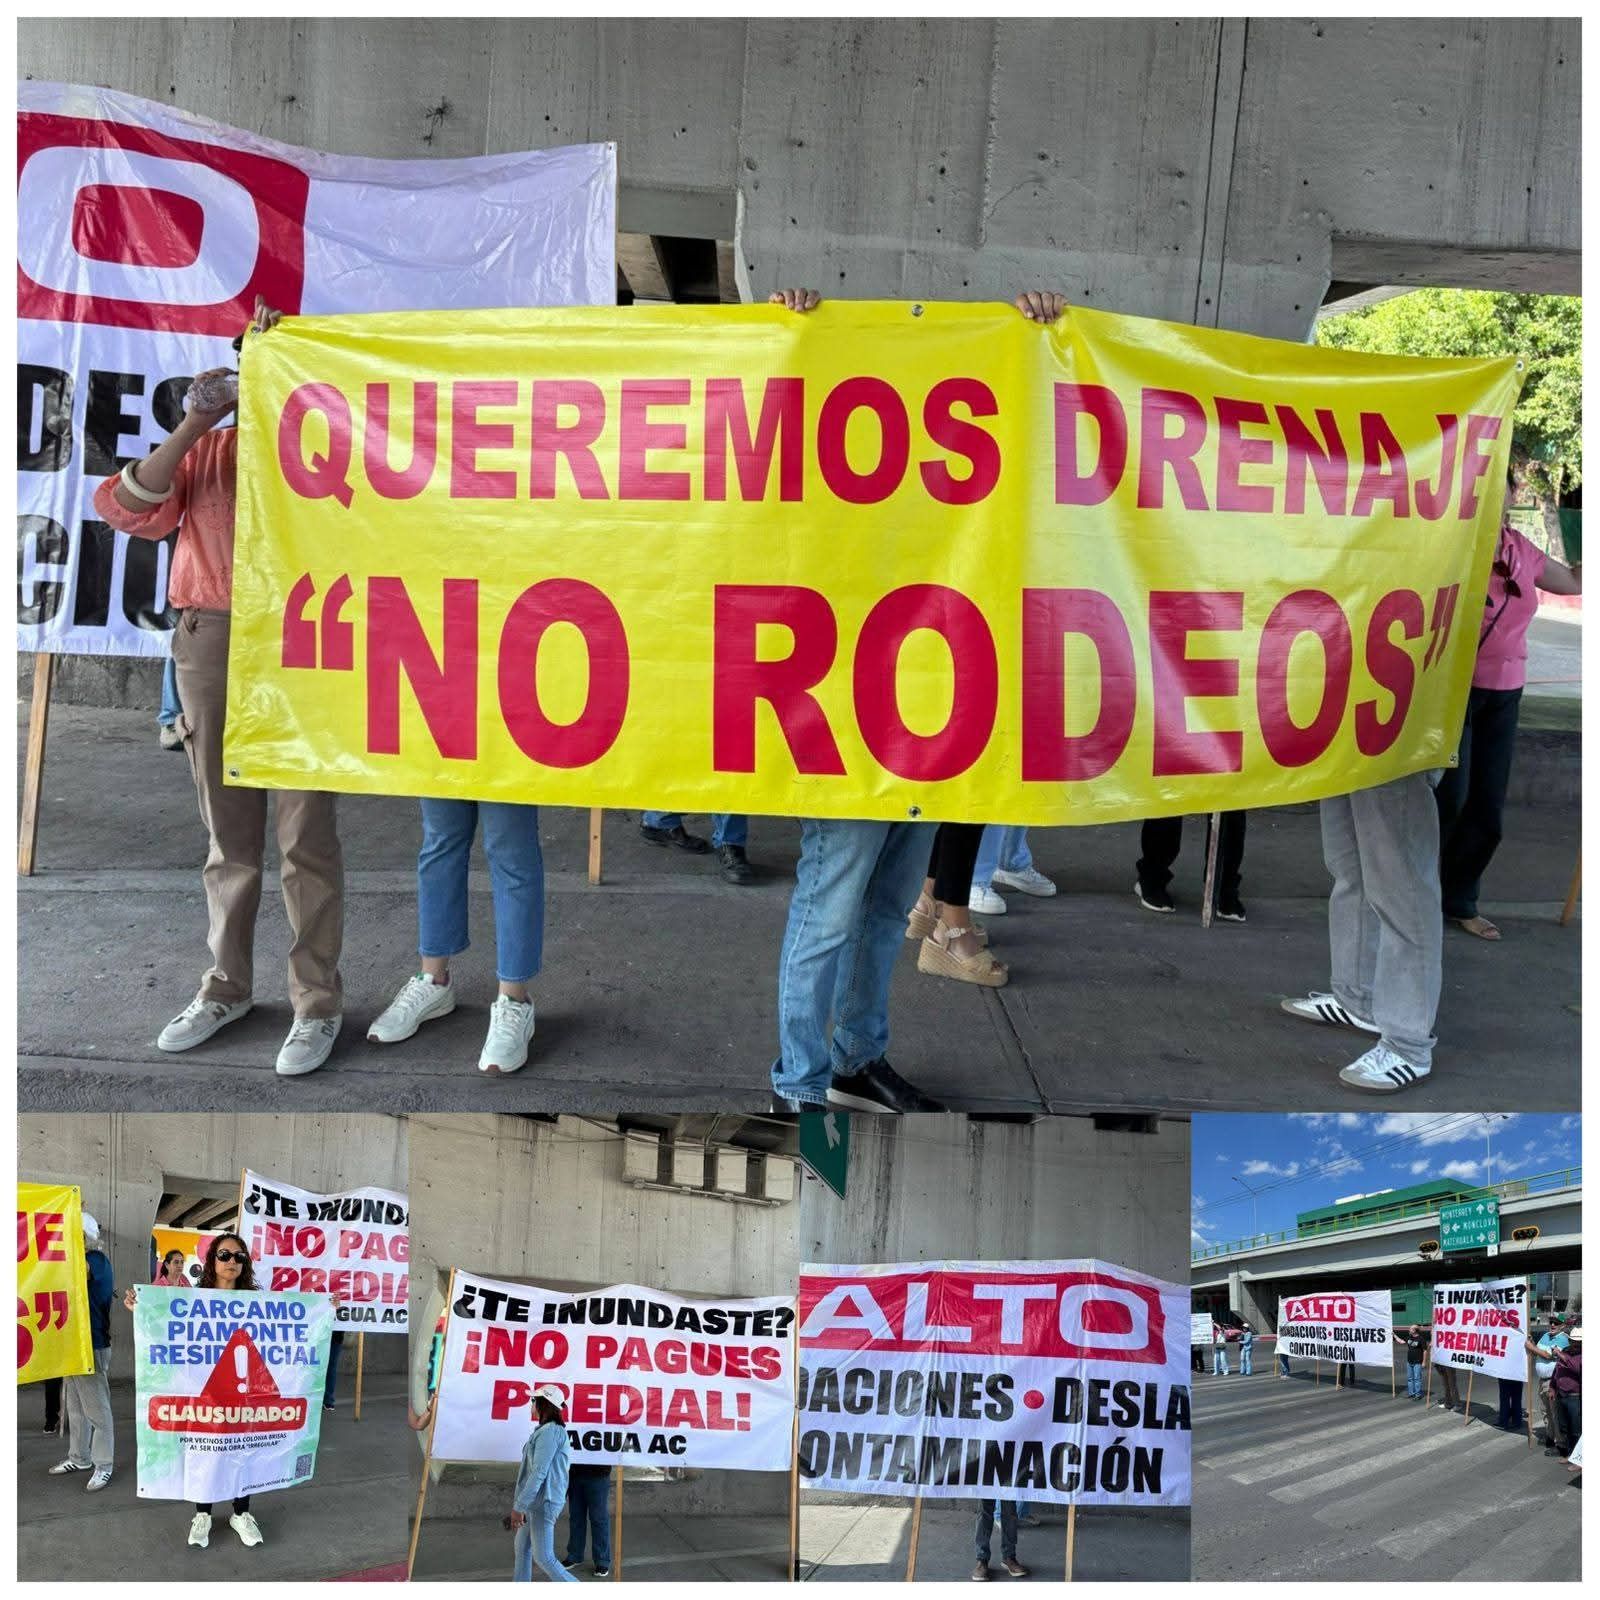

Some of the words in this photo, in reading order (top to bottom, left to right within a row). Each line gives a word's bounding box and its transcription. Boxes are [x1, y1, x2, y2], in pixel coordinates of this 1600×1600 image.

[277, 376, 1002, 510] QUEREMOS
[1054, 382, 1502, 520] DRENAJE
[281, 571, 631, 769] “NO
[713, 583, 1460, 782] RODEOS”
[244, 1184, 299, 1220] ¿TE
[306, 1198, 408, 1227] INUND
[250, 1222, 326, 1262] ¡NO
[170, 1298, 306, 1321] CARCAMO
[334, 1306, 377, 1323] GUA
[381, 1308, 408, 1324] AC
[452, 1284, 532, 1323] ¿TE
[542, 1297, 796, 1339] INUNDASTE?
[800, 1282, 1149, 1351] ALTO
[1289, 1298, 1352, 1320] ALTO
[1434, 1307, 1457, 1326] NO
[168, 1321, 309, 1343] PIAMONTE
[1333, 1327, 1386, 1344] DESLAVES
[1436, 1330, 1508, 1358] PREDIAL!
[150, 1344, 321, 1366] RESICIAL
[461, 1326, 569, 1374] ¡NO
[585, 1335, 782, 1381] PAGUES
[157, 1404, 301, 1424] CLAUSURADO!
[1051, 1376, 1192, 1431] DESLA
[194, 1437, 223, 1445] VECINOS
[224, 1437, 233, 1445] DE
[233, 1436, 242, 1444] LA
[242, 1434, 268, 1443] COLONIA
[213, 1444, 228, 1452] UNA
[229, 1443, 246, 1451] OBRA
[566, 1429, 640, 1454] AGUA
[647, 1433, 687, 1455] AC
